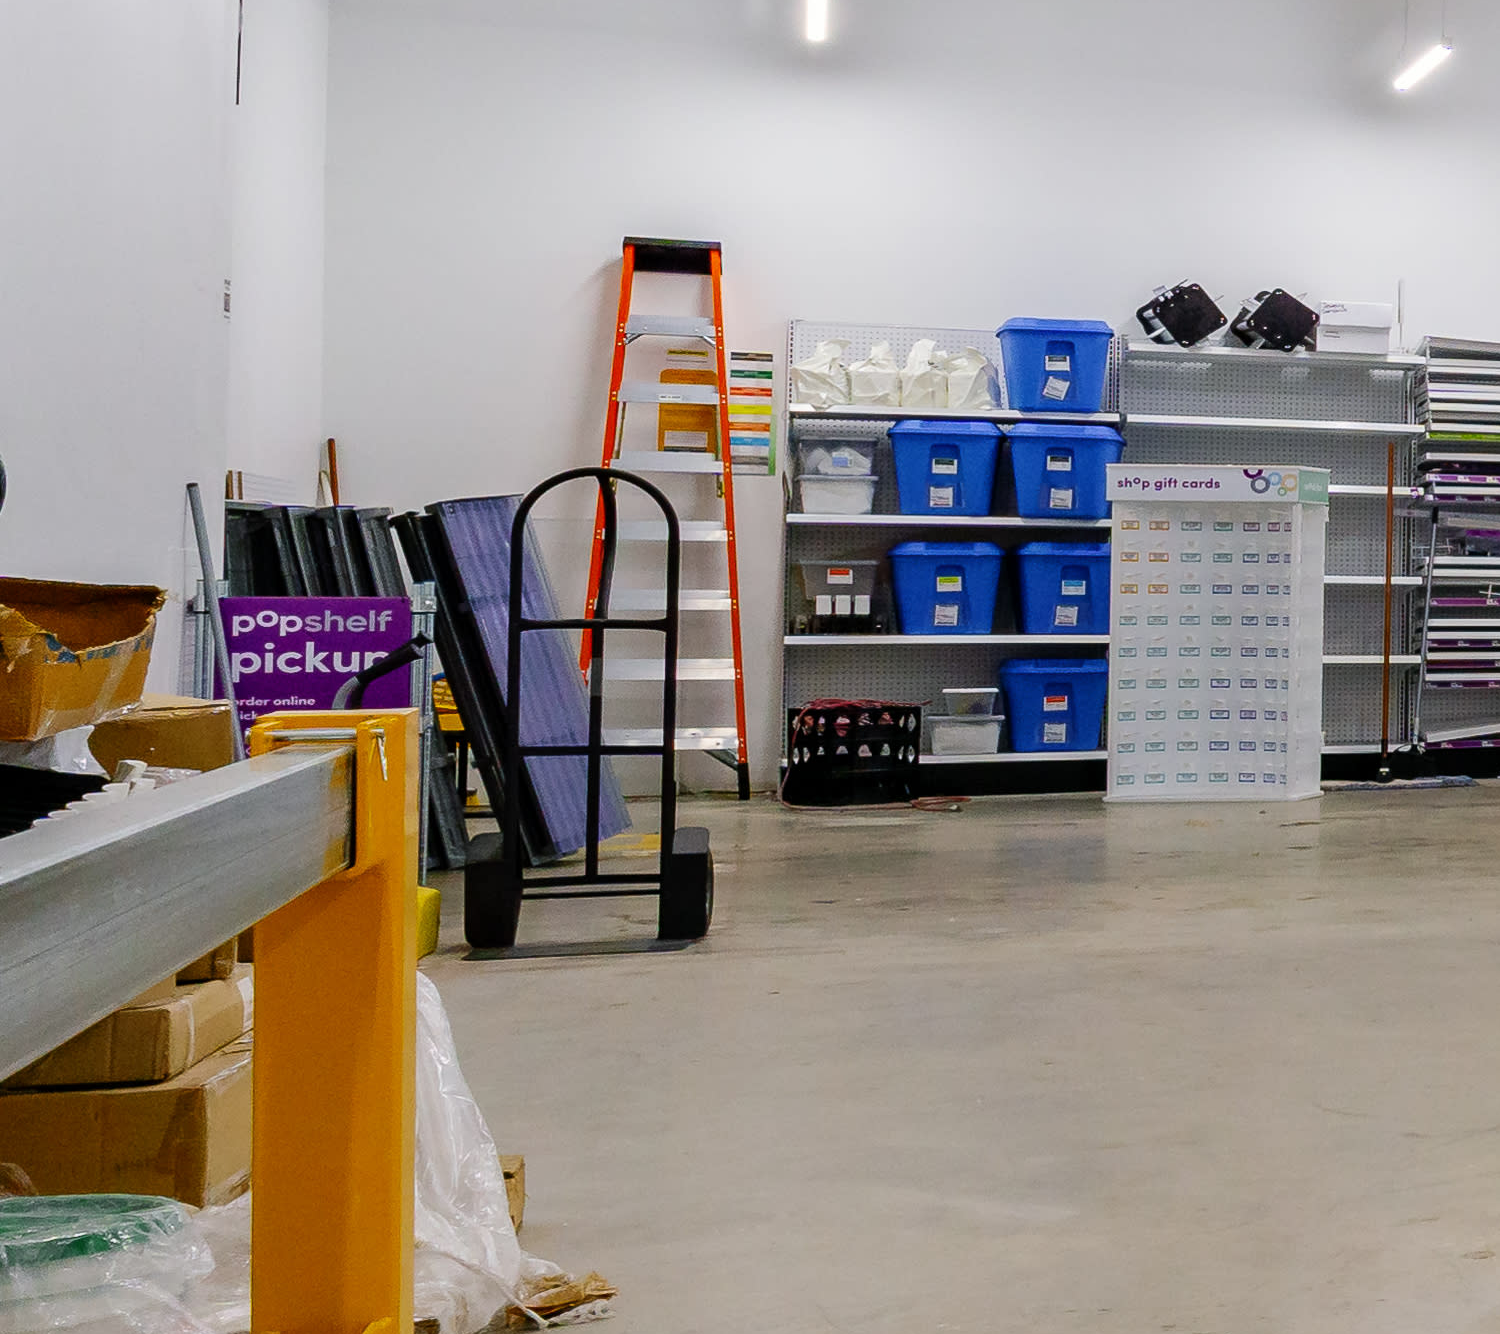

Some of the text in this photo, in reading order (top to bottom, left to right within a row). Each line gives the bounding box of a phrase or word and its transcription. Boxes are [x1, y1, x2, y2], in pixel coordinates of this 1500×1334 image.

[1117, 477, 1221, 491] shop gift cards
[231, 610, 393, 637] popshelf
[273, 696, 316, 707] online
[239, 710, 258, 721] ick
